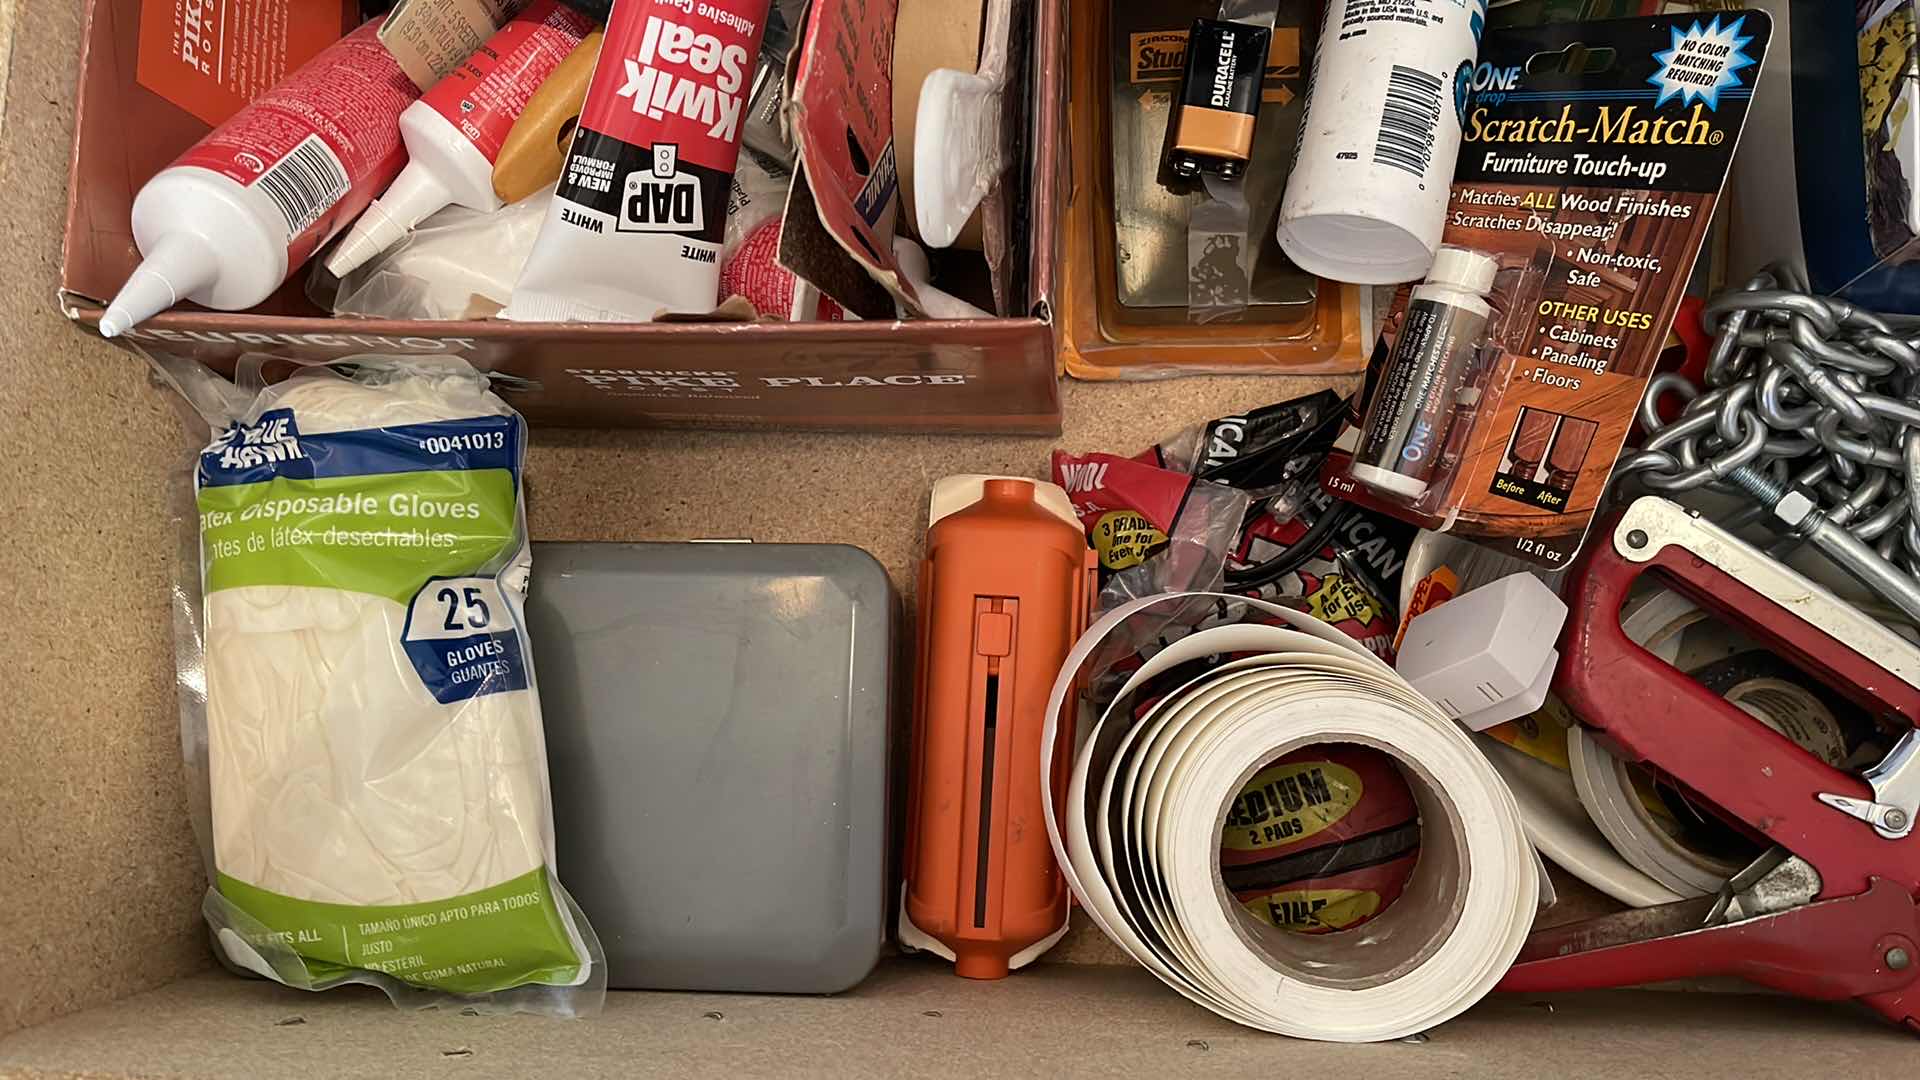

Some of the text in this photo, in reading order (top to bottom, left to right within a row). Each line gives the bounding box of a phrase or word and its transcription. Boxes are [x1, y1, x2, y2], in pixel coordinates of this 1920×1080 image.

[174, 0, 184, 26] STO
[697, 3, 755, 37] Adhesive
[182, 0, 202, 70] PIK
[638, 15, 748, 94] Seal
[1681, 39, 1730, 58] NO COLOR
[1471, 61, 1521, 92] ONE
[1672, 54, 1724, 73] MATCHING
[1665, 69, 1718, 88] REQUIRED!
[616, 59, 742, 143] Kwik
[1476, 89, 1507, 105] drop
[1422, 133, 1435, 168] 70798
[1430, 94, 1443, 127] 18071
[570, 163, 613, 180] IMPROVED
[573, 154, 615, 171] FORMULA
[1481, 152, 1667, 184] Furniture Touch-up
[579, 178, 611, 193] NEW
[1459, 188, 1692, 219] Matches ALL Wood Finishes
[561, 208, 604, 234] WHITE
[1452, 211, 1618, 242] Scratches Disappear!
[681, 245, 716, 263] WHITE
[1576, 247, 1662, 274] Non-toxic,
[1566, 269, 1601, 289] Safe
[1539, 300, 1653, 331] OTHER USES
[1549, 324, 1619, 349] Cabinets
[1540, 346, 1608, 375] Paneling
[575, 374, 966, 388] PIKE PLACE
[1532, 367, 1581, 391] Floors
[1402, 419, 1432, 462] ONE
[1327, 475, 1355, 494] 15 ml
[1496, 479, 1562, 505] Before After
[200, 507, 233, 533] atex
[388, 494, 480, 519] Gloves
[247, 534, 265, 554] de
[271, 527, 313, 551] látex
[322, 525, 456, 550] desechables
[1102, 522, 1111, 537] 3
[1516, 537, 1562, 562] 1/2 fl oz
[437, 587, 490, 630] 25
[1323, 599, 1342, 619] for
[447, 639, 504, 667] GLOVES
[451, 659, 511, 684] GUANTES
[1226, 767, 1332, 827] EDIUM
[1250, 818, 1303, 845] 2 PADS
[359, 918, 401, 936] TAMAÑO
[440, 907, 468, 924] APTO
[470, 900, 501, 918] PARA
[502, 891, 540, 911] TODOS
[298, 929, 322, 943] ALL
[361, 940, 393, 956] JUSTO
